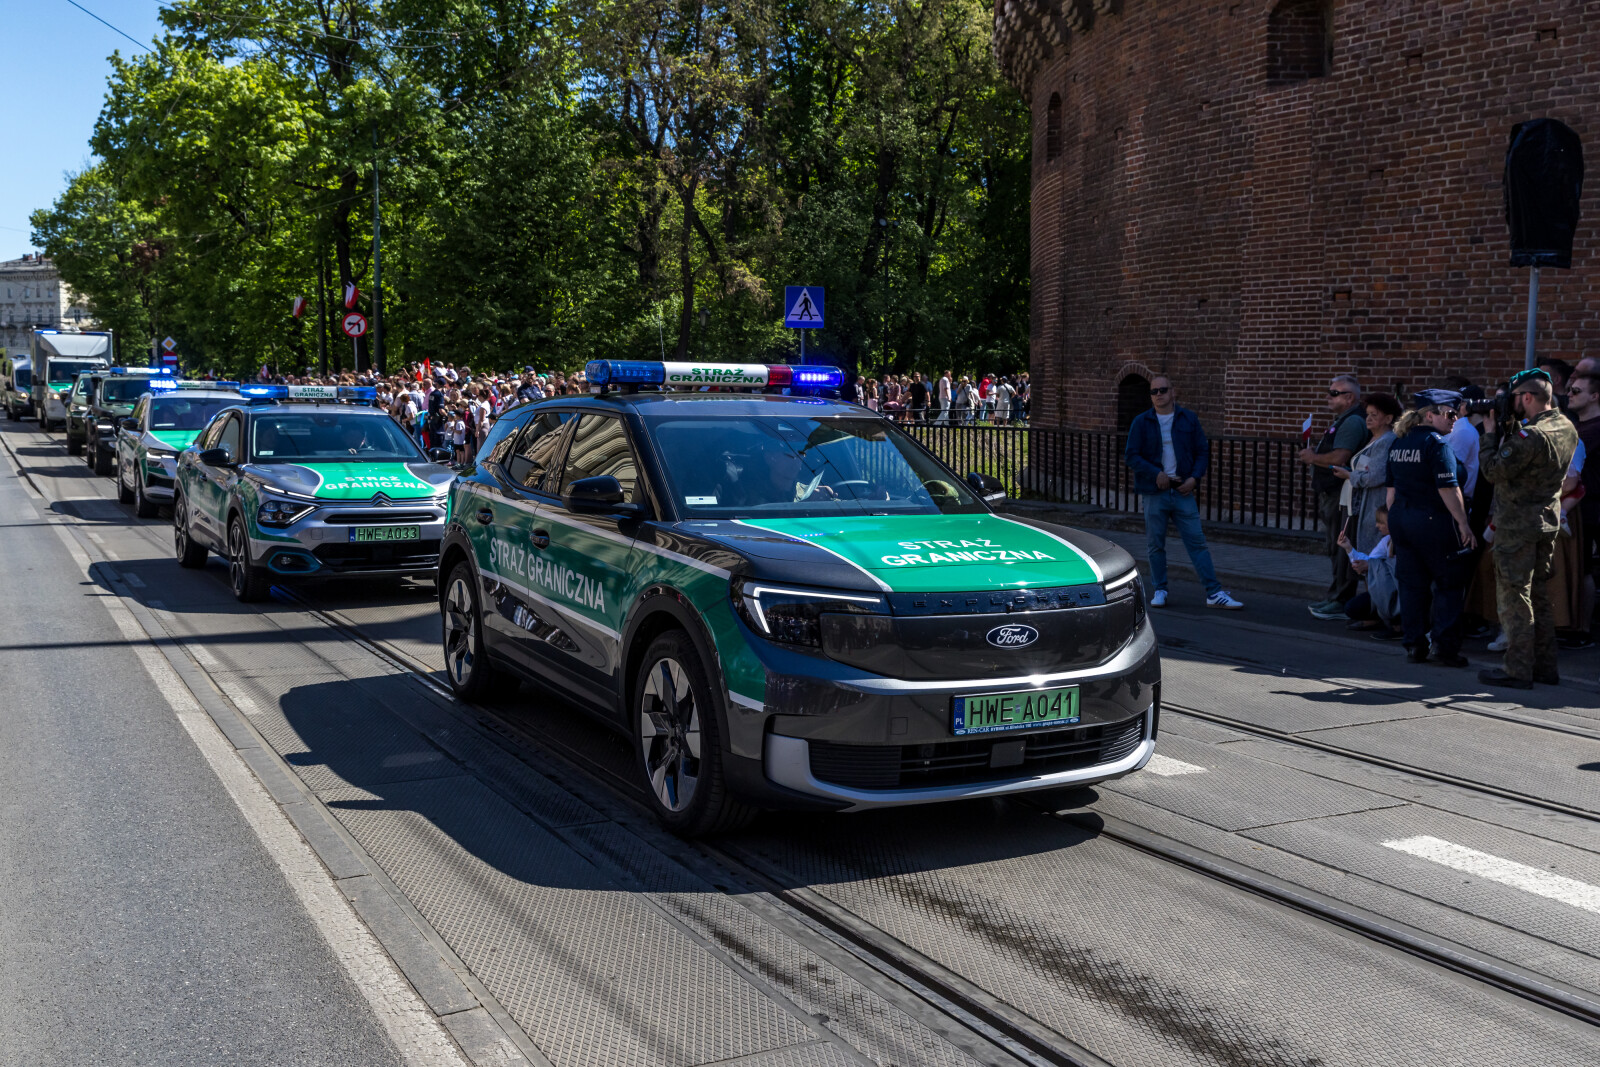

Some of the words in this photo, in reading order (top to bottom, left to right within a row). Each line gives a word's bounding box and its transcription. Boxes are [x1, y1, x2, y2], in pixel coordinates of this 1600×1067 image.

[669, 375, 764, 383] GRANICZNA
[691, 368, 744, 376] STRAŻ
[1389, 449, 1421, 463] POLICJA
[325, 481, 428, 490] GRANICZNA
[358, 528, 382, 541] HWE
[387, 527, 417, 539] A033
[897, 538, 1001, 550] STRAŻ
[881, 550, 1056, 566] GRANICZNA
[489, 537, 525, 577] STRAŻ
[527, 553, 606, 613] GRANICZNA
[913, 592, 1091, 608] EXPLORER
[996, 627, 1029, 645] Ford
[970, 697, 1013, 725] HWE
[1023, 691, 1073, 720] A041
[955, 717, 964, 725] PL
